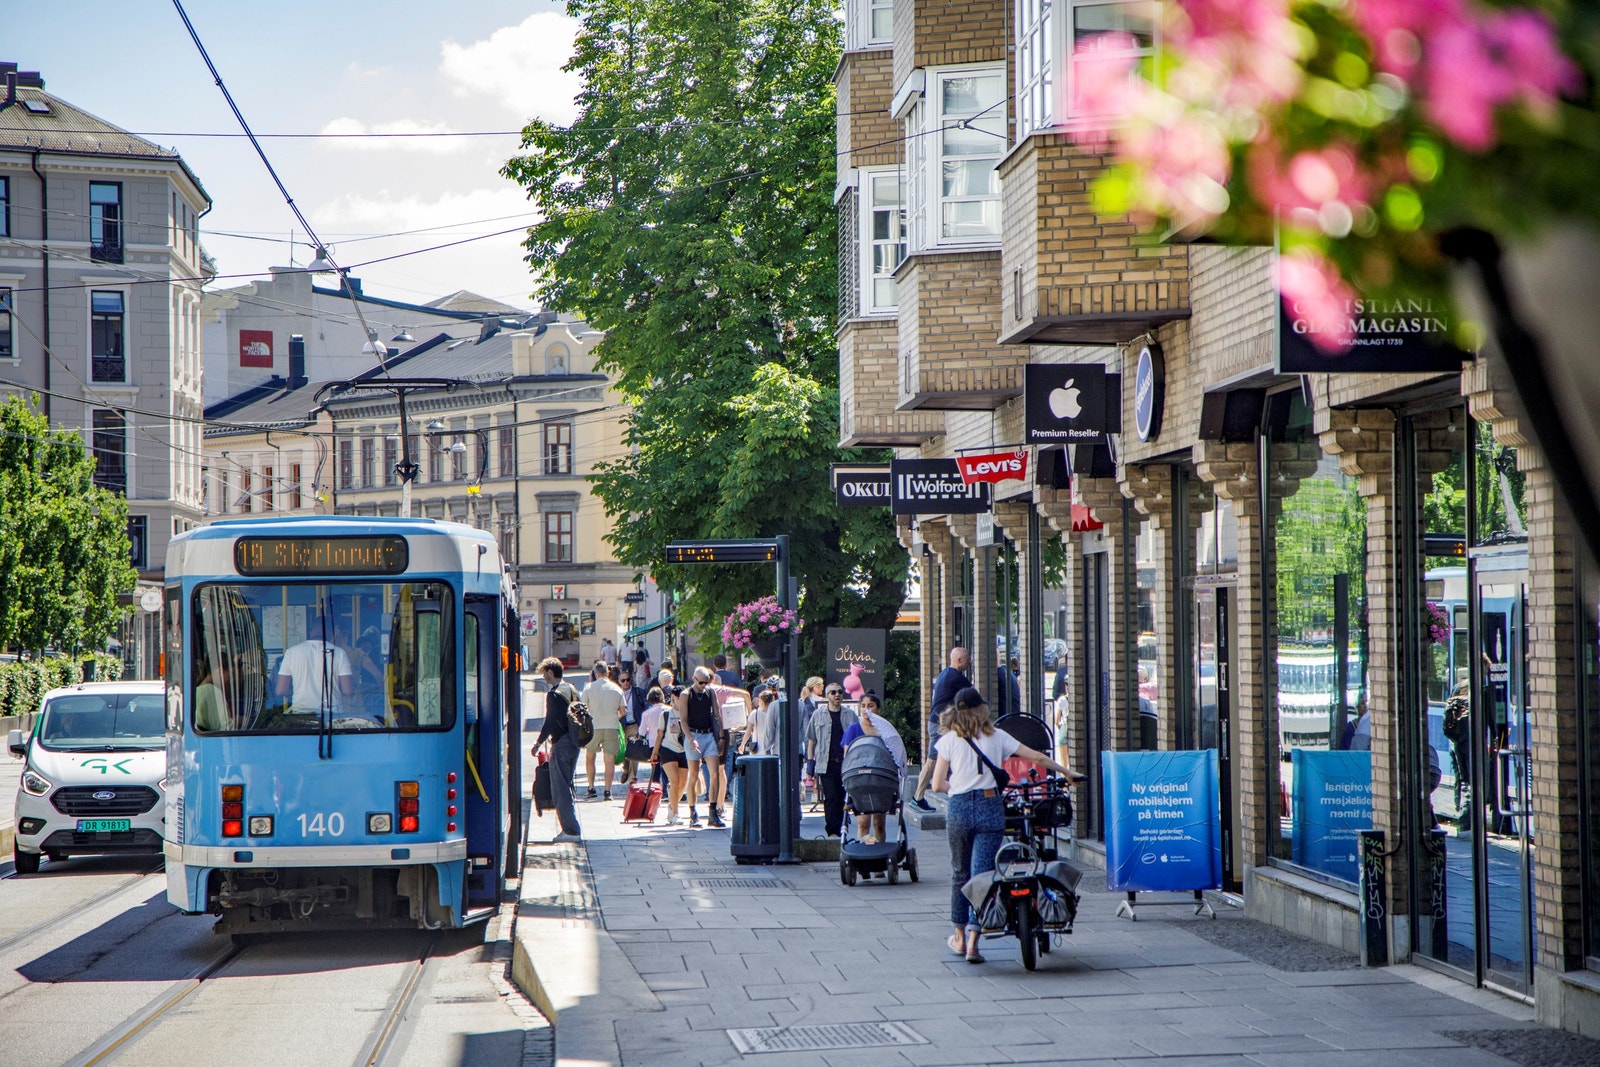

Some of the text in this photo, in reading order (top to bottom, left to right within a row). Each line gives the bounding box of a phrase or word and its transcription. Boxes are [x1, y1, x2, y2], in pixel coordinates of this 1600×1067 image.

[1293, 299, 1448, 314] CISTIANI
[1292, 317, 1449, 334] GLSMAGASIN
[1337, 338, 1404, 346] GRUNNLAGT 1739
[1031, 429, 1100, 438] Premium Reseller
[912, 480, 967, 493] Wolford
[835, 645, 873, 661] Olivia
[80, 758, 135, 775] GK
[1132, 782, 1188, 794] Ny original
[1128, 796, 1193, 807] mobilskjerm
[1138, 809, 1184, 821] på timen
[85, 821, 127, 830] DR 91813
[296, 811, 345, 838] 140
